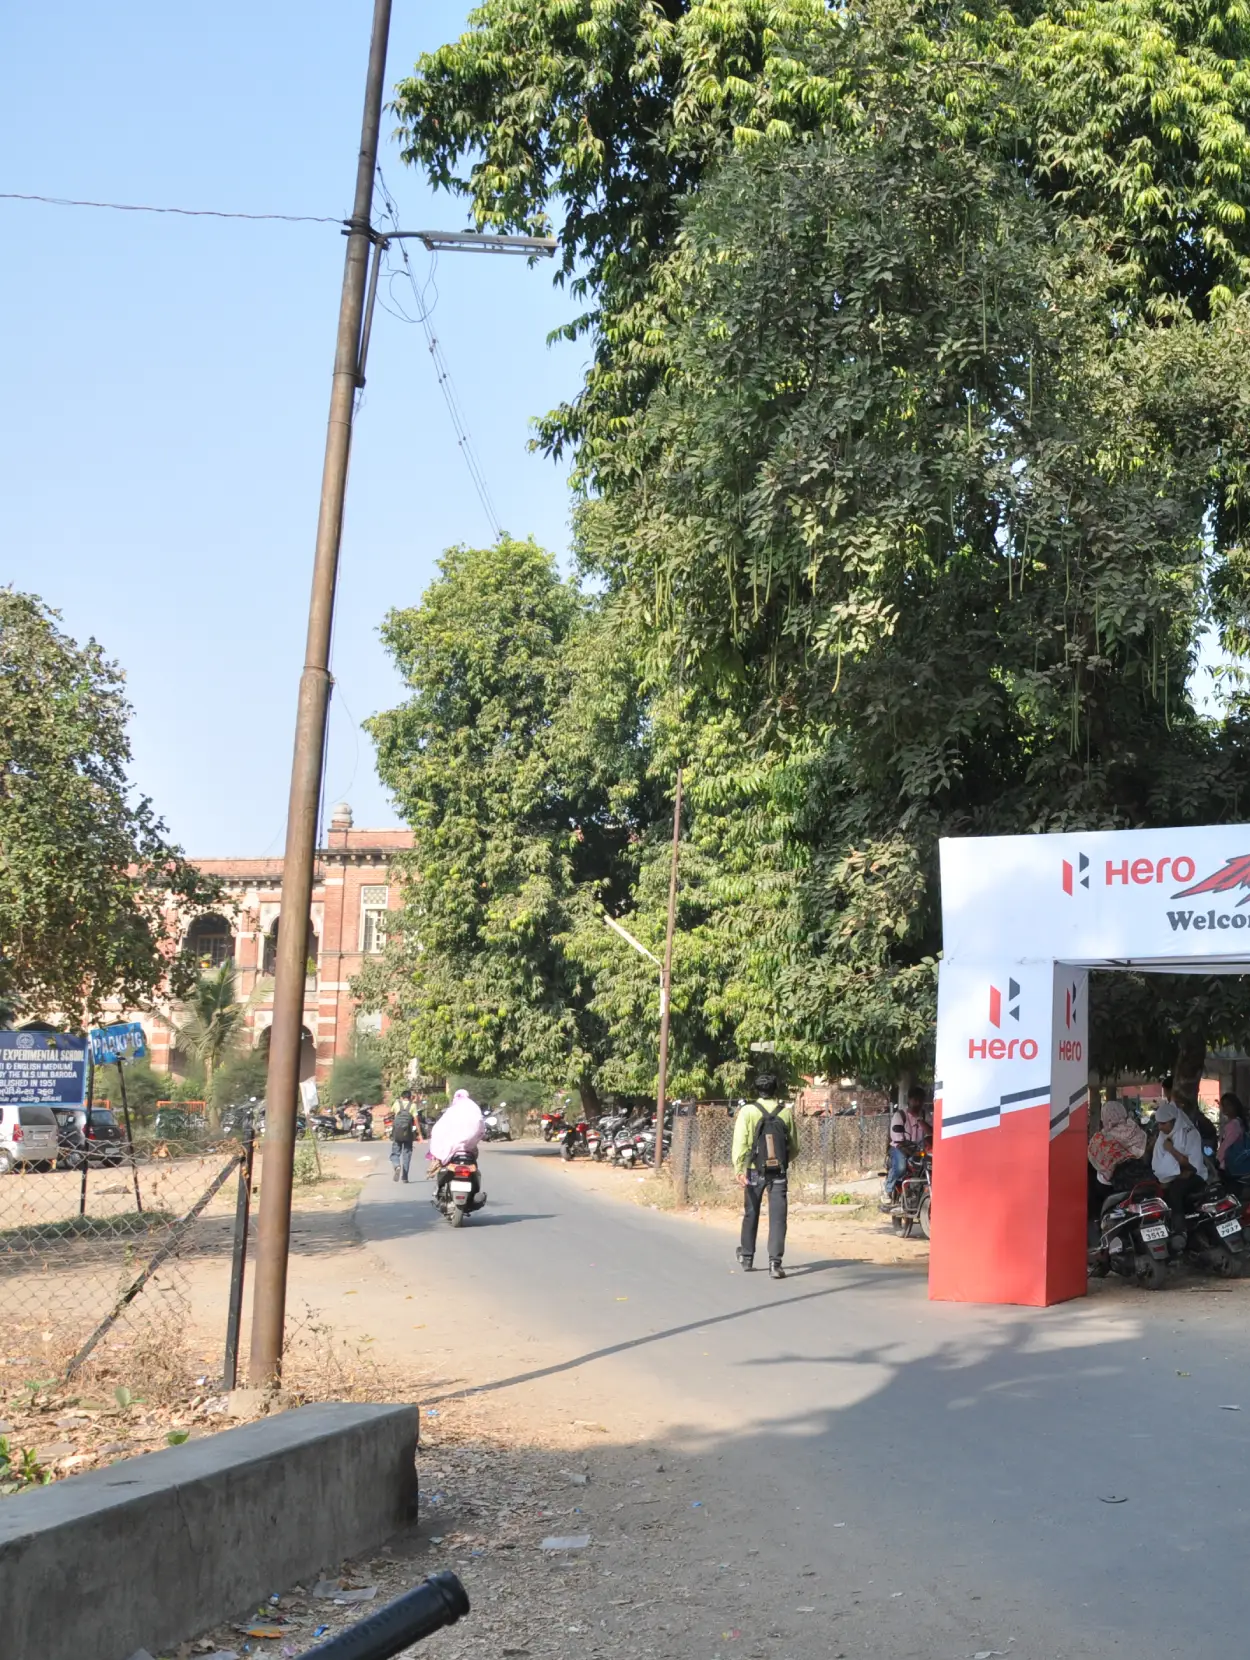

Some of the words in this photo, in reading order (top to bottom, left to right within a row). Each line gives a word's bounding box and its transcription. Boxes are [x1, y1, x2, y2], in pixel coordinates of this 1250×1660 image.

[1106, 855, 1196, 886] Hero
[3, 1049, 59, 1061] EXPERIMENTAL
[61, 1050, 84, 1061] SCHOOL
[969, 1038, 1038, 1060] Hero
[1059, 1040, 1081, 1062] Hero
[1145, 1230, 1166, 1241] 3512
